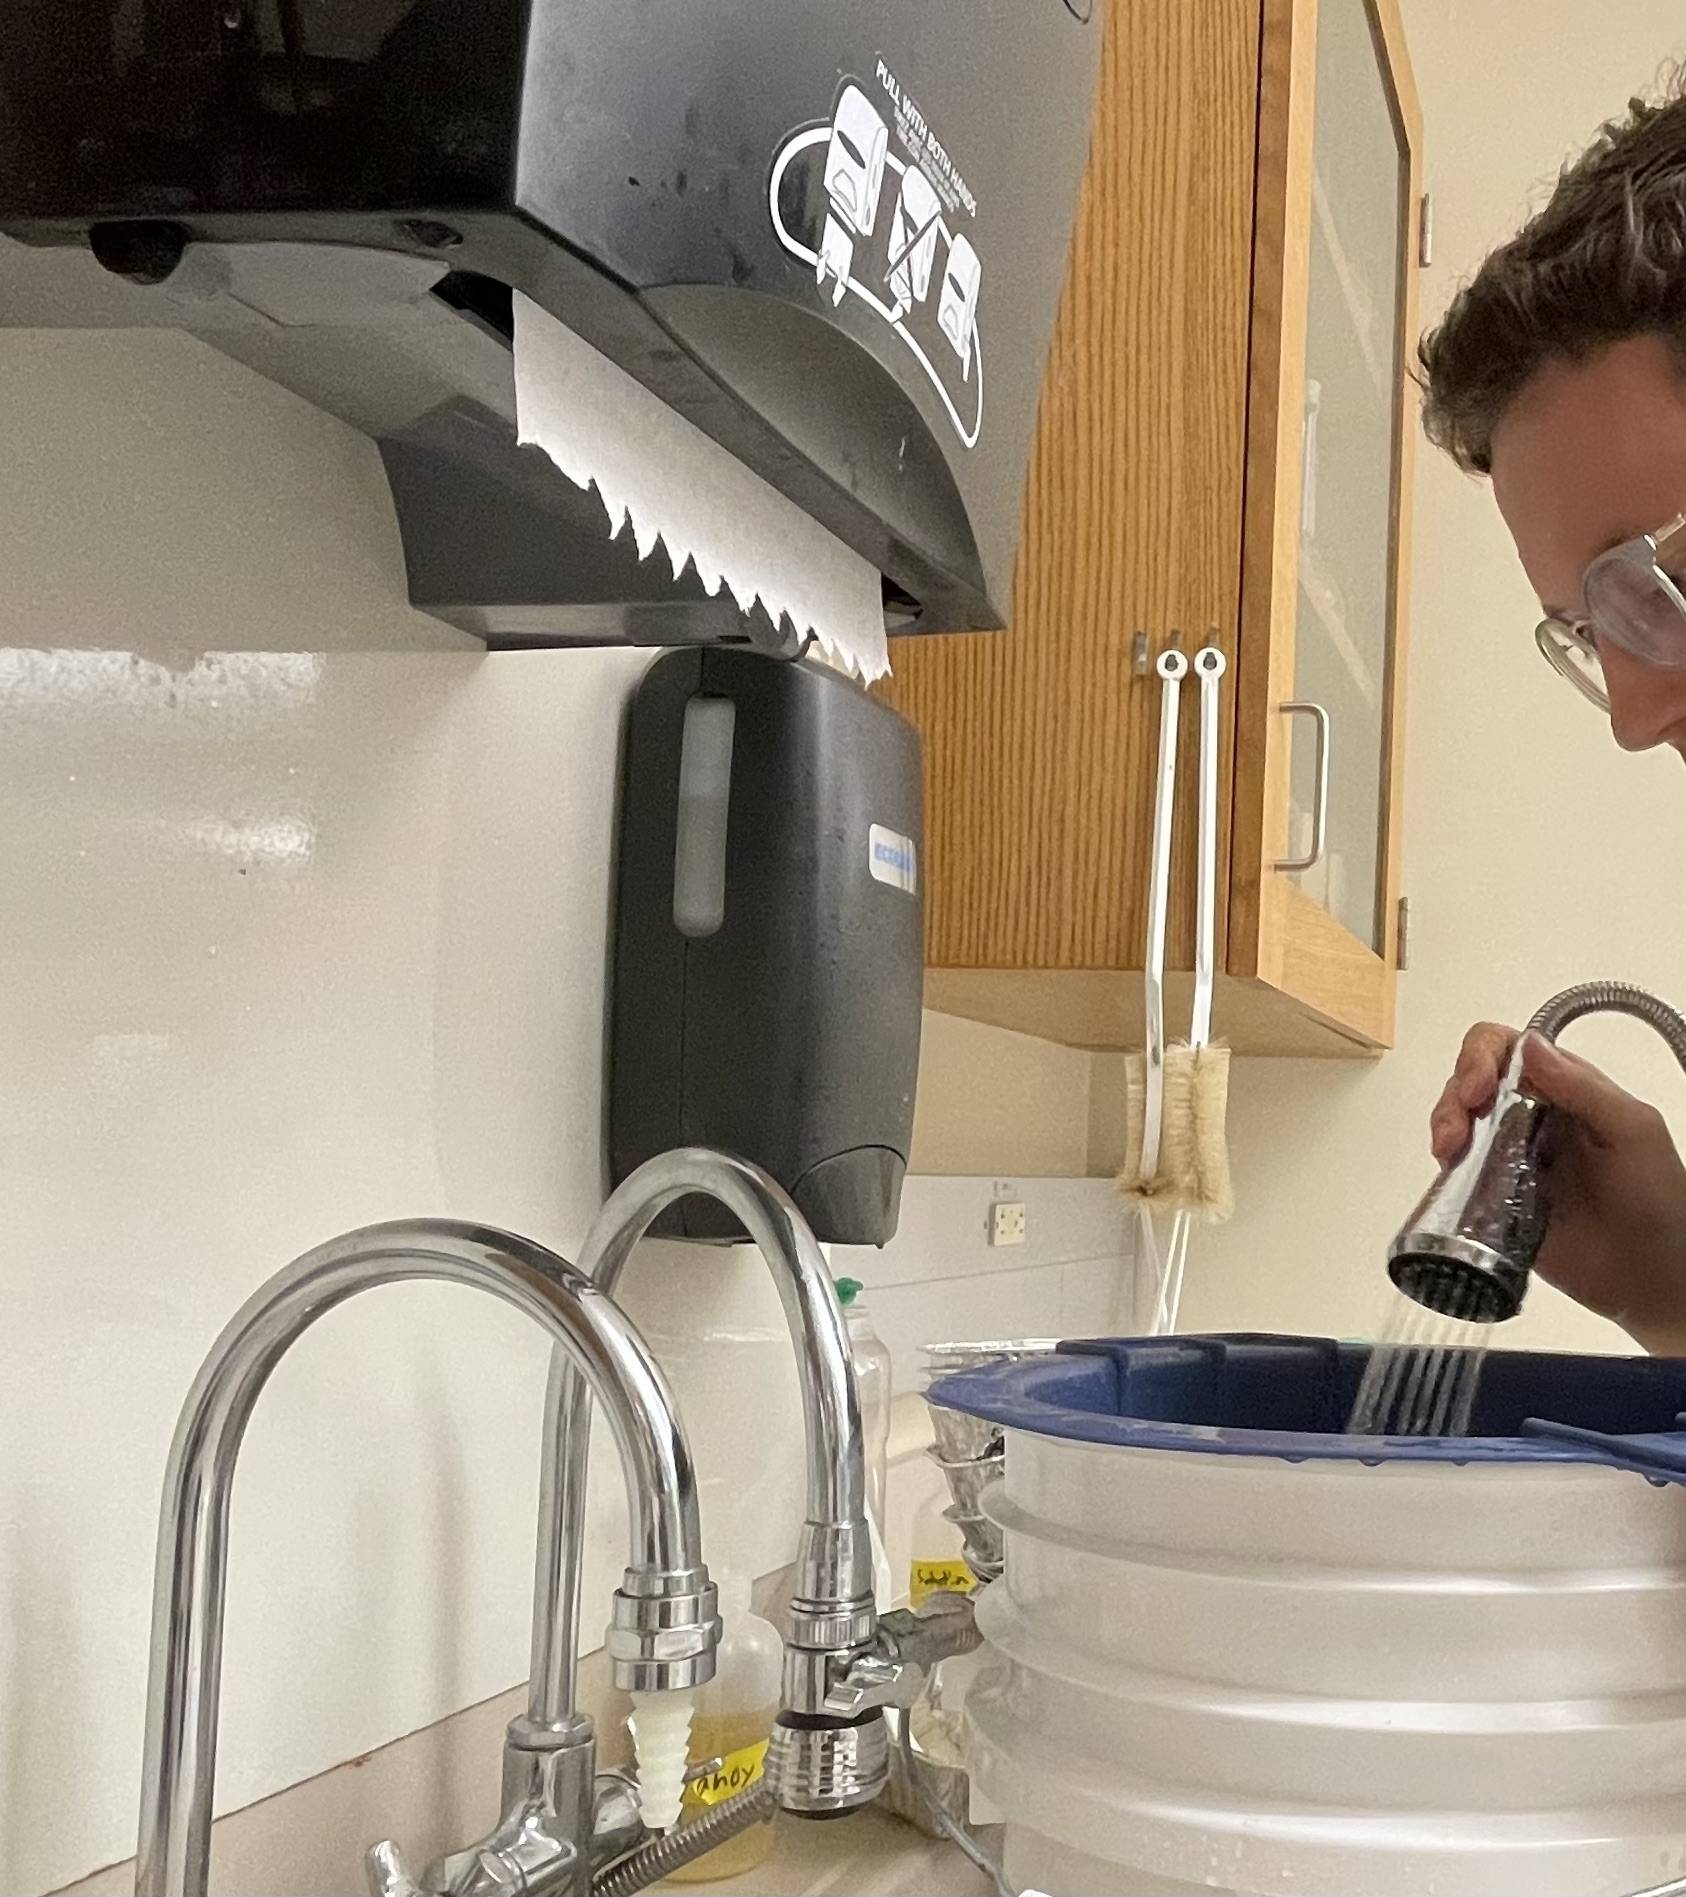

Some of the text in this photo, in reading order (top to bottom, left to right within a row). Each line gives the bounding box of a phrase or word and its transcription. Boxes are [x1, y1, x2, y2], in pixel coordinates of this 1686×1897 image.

[876, 59, 977, 217] PULL WITH BOTH HANDS
